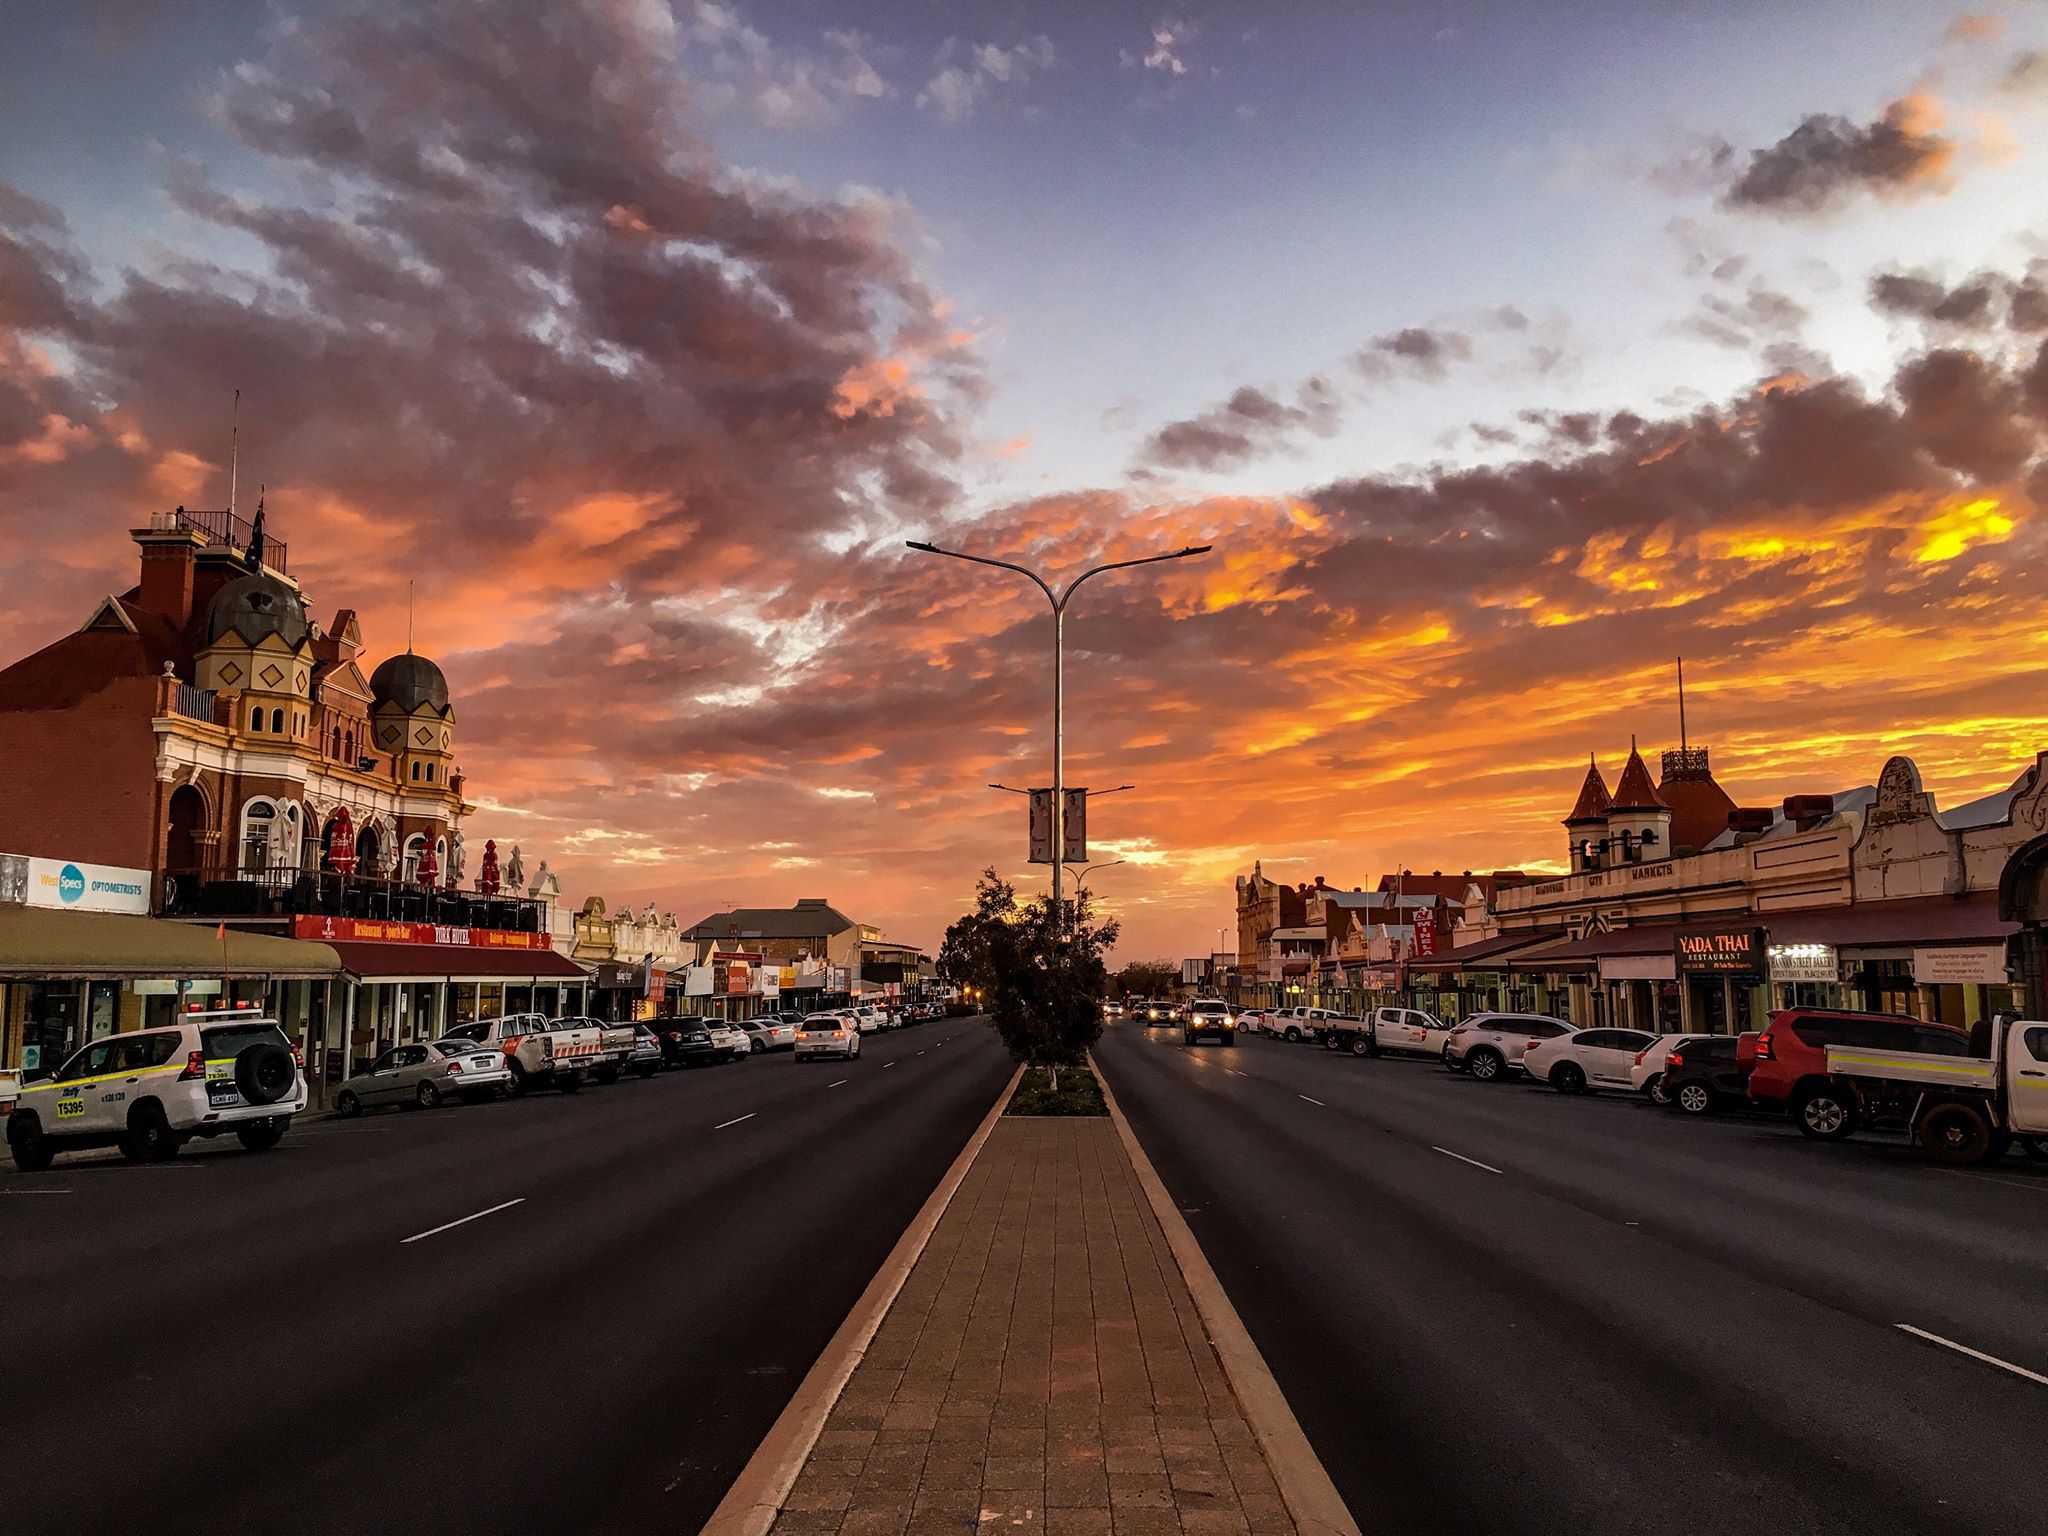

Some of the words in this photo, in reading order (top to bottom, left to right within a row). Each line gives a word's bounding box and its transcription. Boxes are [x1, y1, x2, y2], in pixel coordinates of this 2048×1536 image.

[41, 873, 58, 887] West
[60, 875, 82, 891] Specs
[1588, 875, 1603, 887] CITY
[1632, 863, 1673, 880] MARKETS
[91, 880, 142, 896] OPTOMETRISTS
[435, 926, 451, 943] YORK
[451, 927, 470, 945] HOTEL
[1680, 936, 1713, 953] YADA
[1715, 934, 1750, 952] THAI
[1688, 952, 1741, 961] RESTAURANT
[1793, 956, 1812, 968] STREET
[1813, 956, 1834, 968] BAKERY
[57, 1101, 84, 1115] T5395
